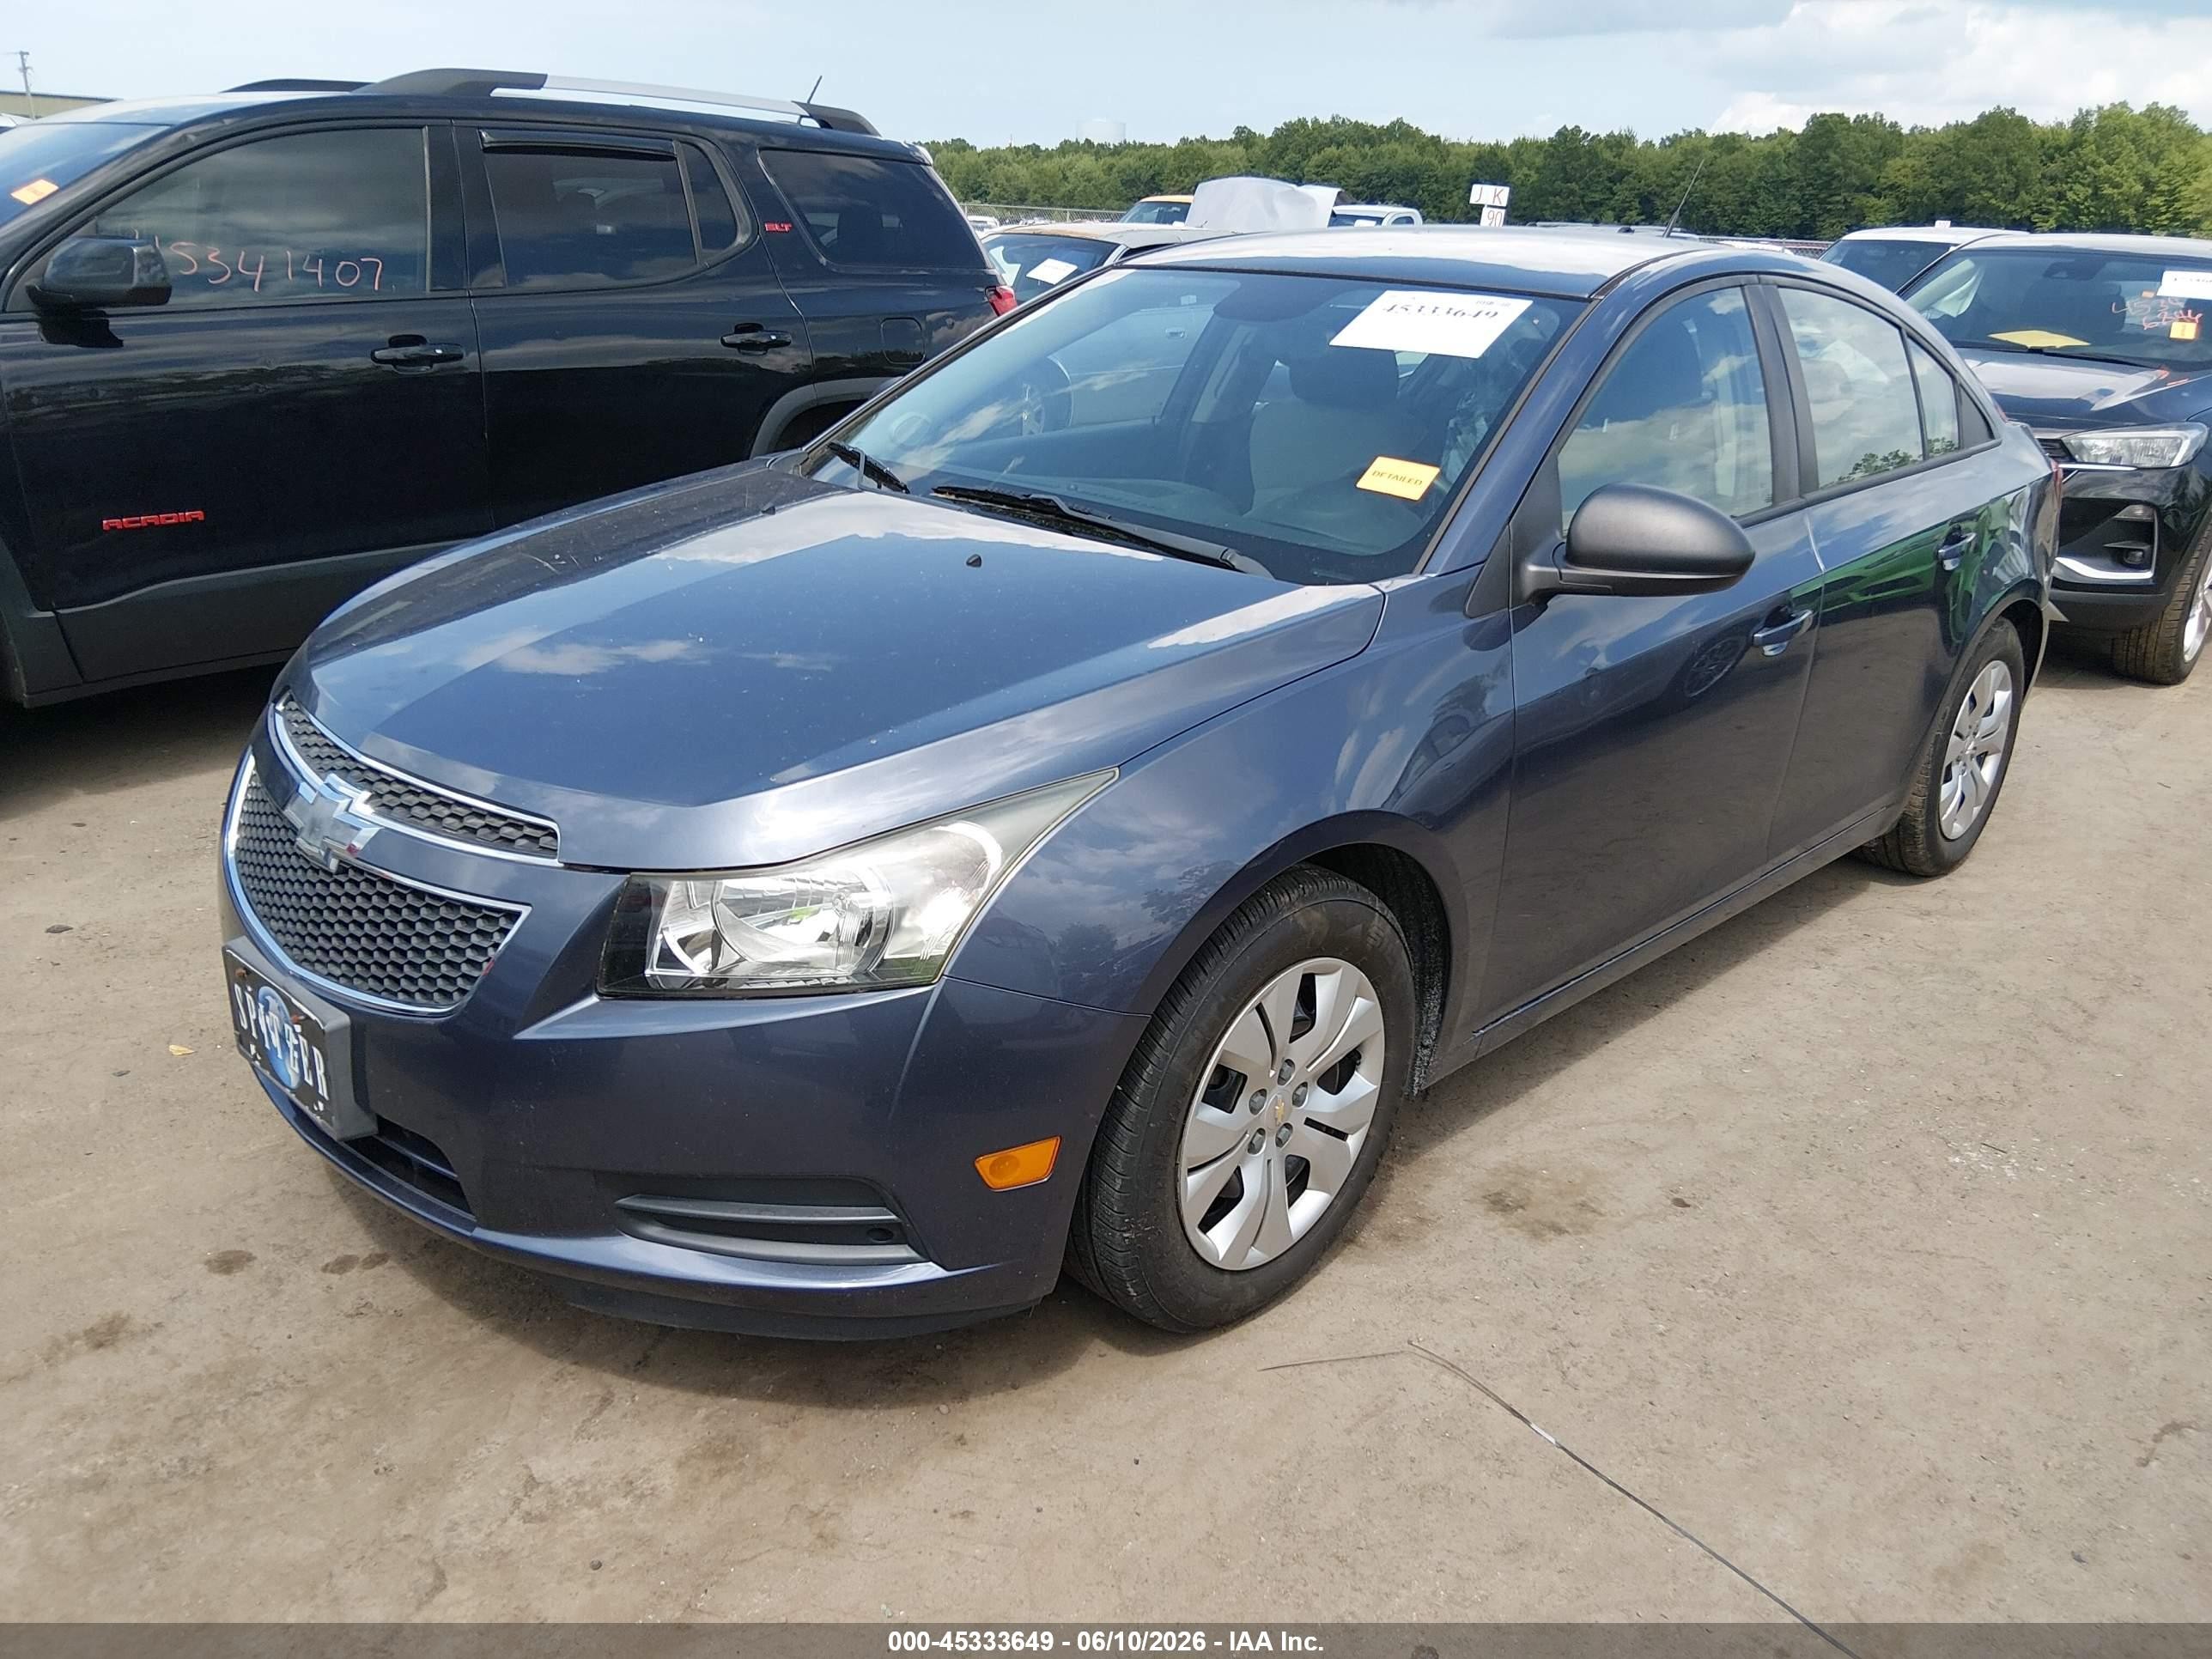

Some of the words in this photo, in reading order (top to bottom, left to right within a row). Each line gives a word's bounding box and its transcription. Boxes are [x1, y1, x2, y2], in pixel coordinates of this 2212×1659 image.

[1492, 187, 1504, 205] K
[133, 228, 384, 292] 5341407
[1371, 470, 1423, 486] DETAILED
[101, 510, 205, 531] ACADIA
